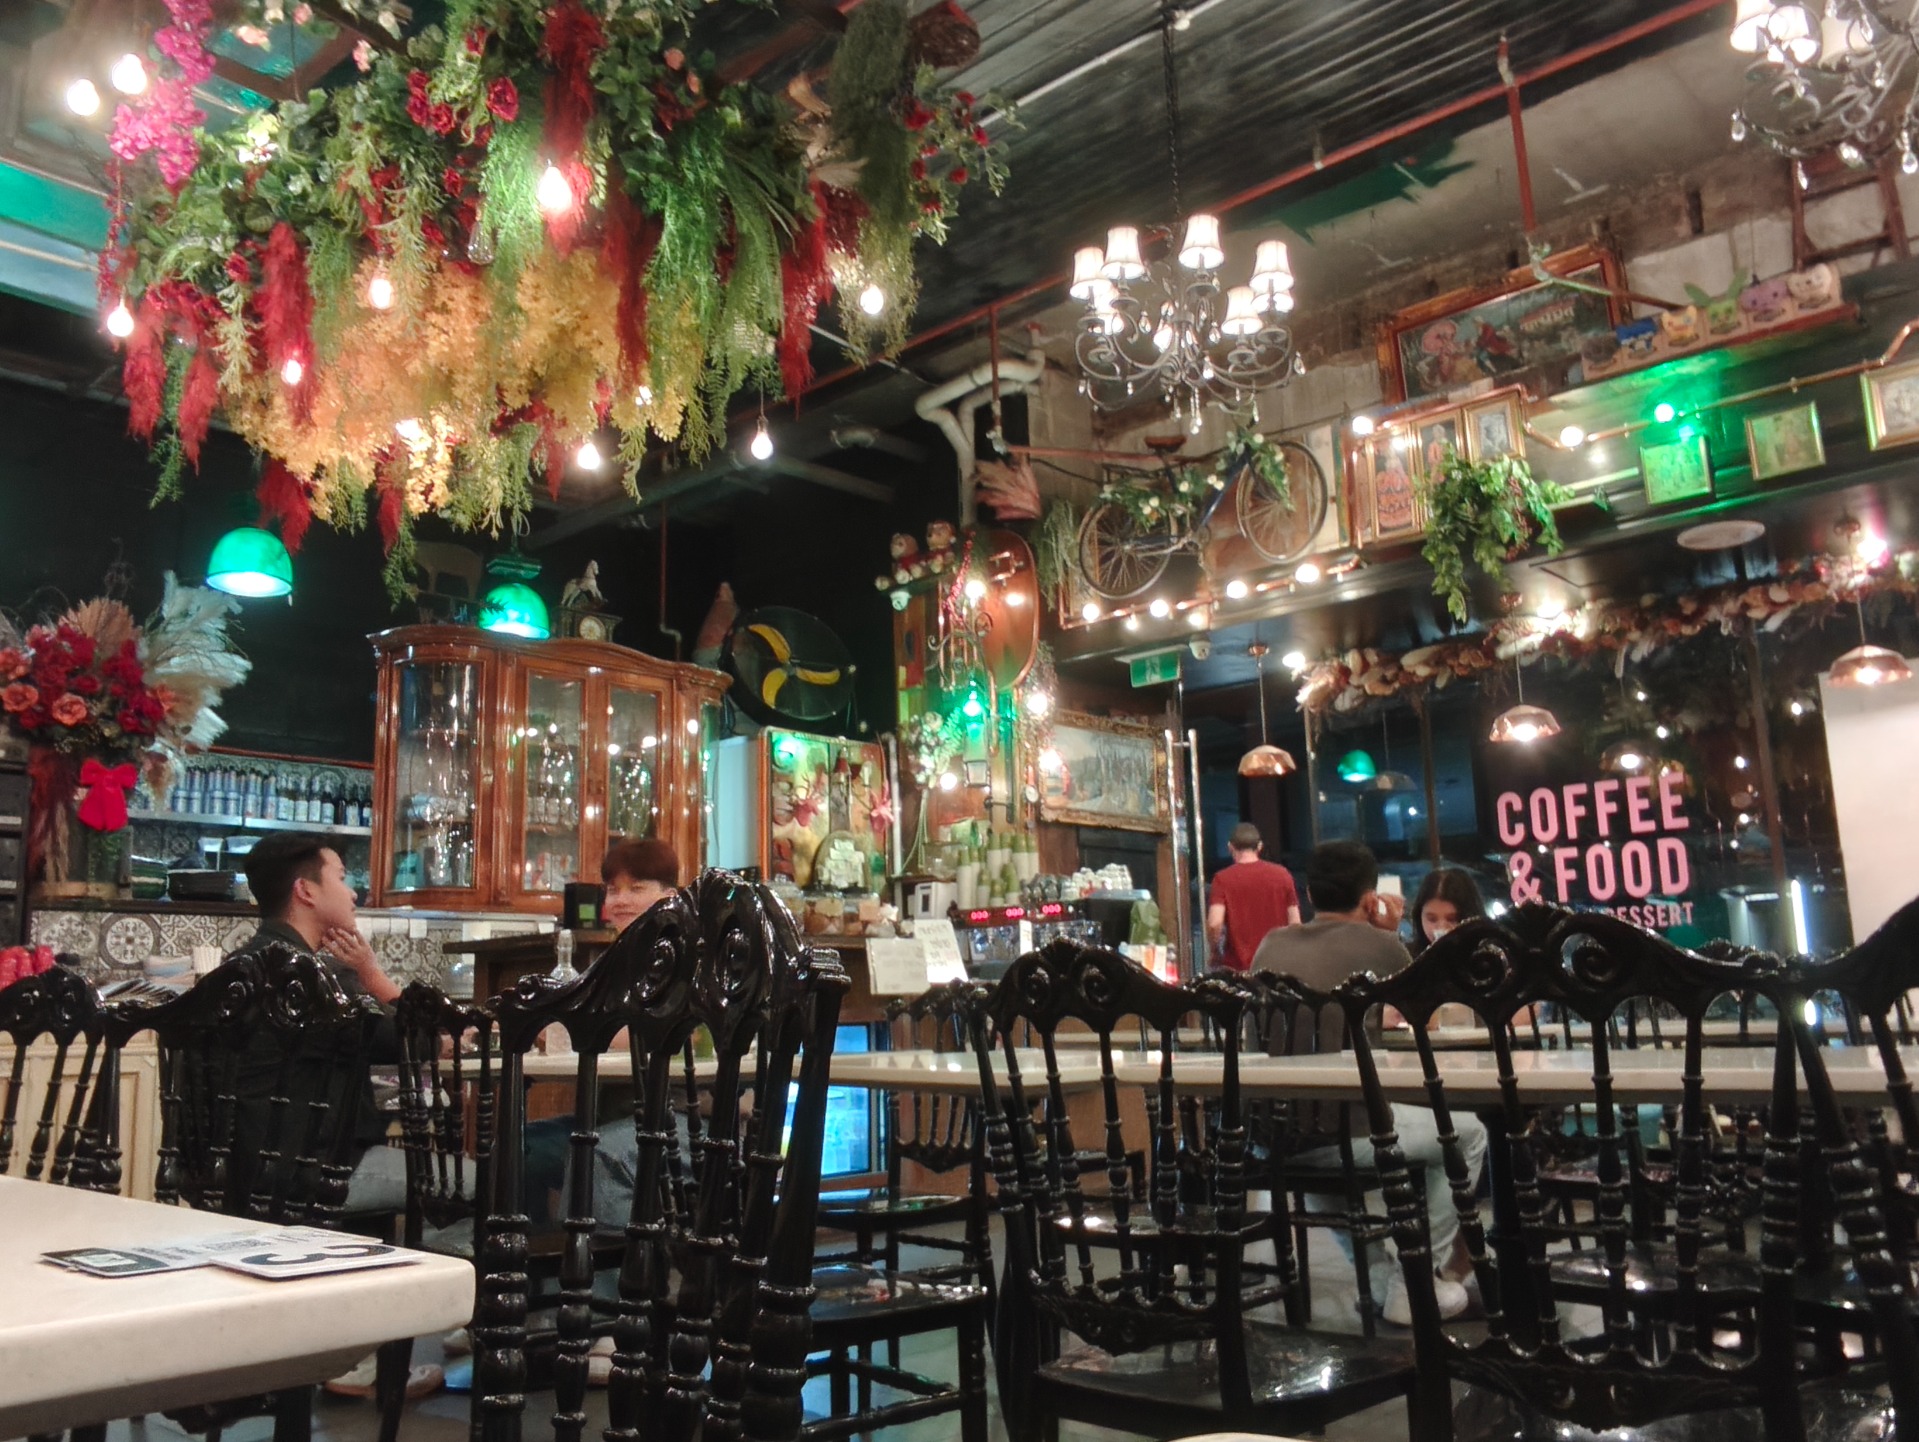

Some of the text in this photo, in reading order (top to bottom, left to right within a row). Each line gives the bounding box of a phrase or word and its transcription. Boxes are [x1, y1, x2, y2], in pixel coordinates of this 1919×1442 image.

[1497, 772, 1689, 846] COFFEE
[1509, 837, 1689, 906] & FOOD
